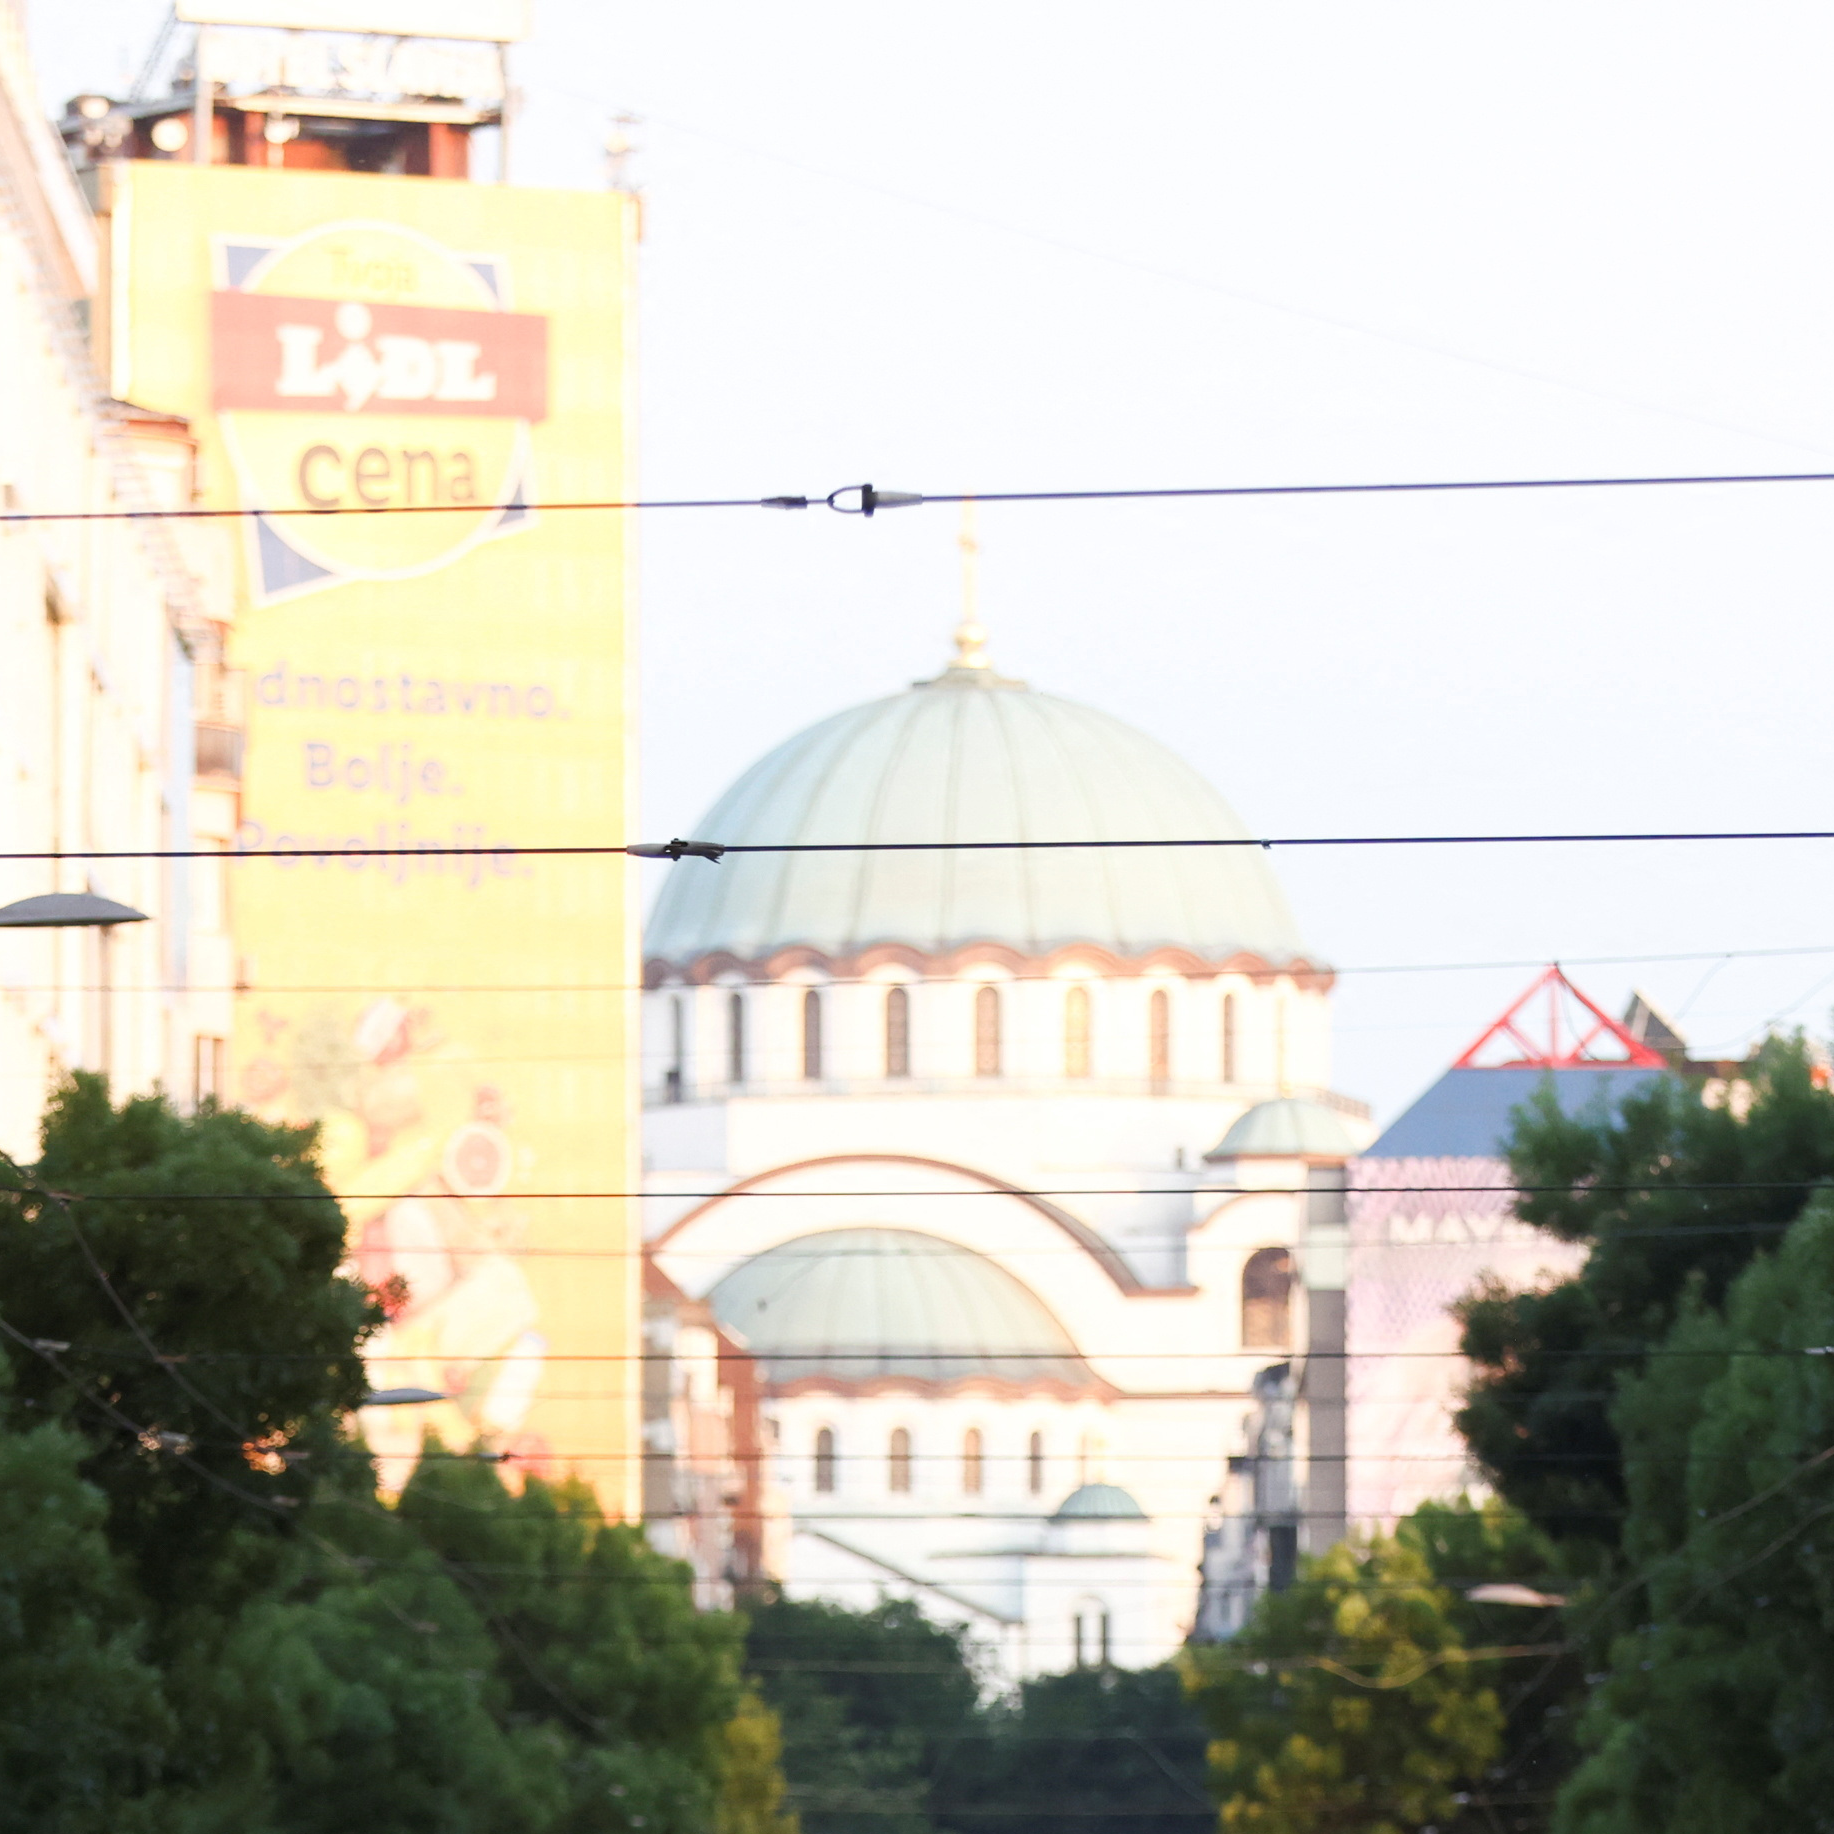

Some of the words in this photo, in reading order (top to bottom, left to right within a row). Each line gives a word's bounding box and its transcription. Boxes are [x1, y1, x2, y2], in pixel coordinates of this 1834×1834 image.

[298, 444, 478, 508] cena
[305, 742, 465, 804] Bolje.
[235, 818, 535, 888] Povoljnije.
